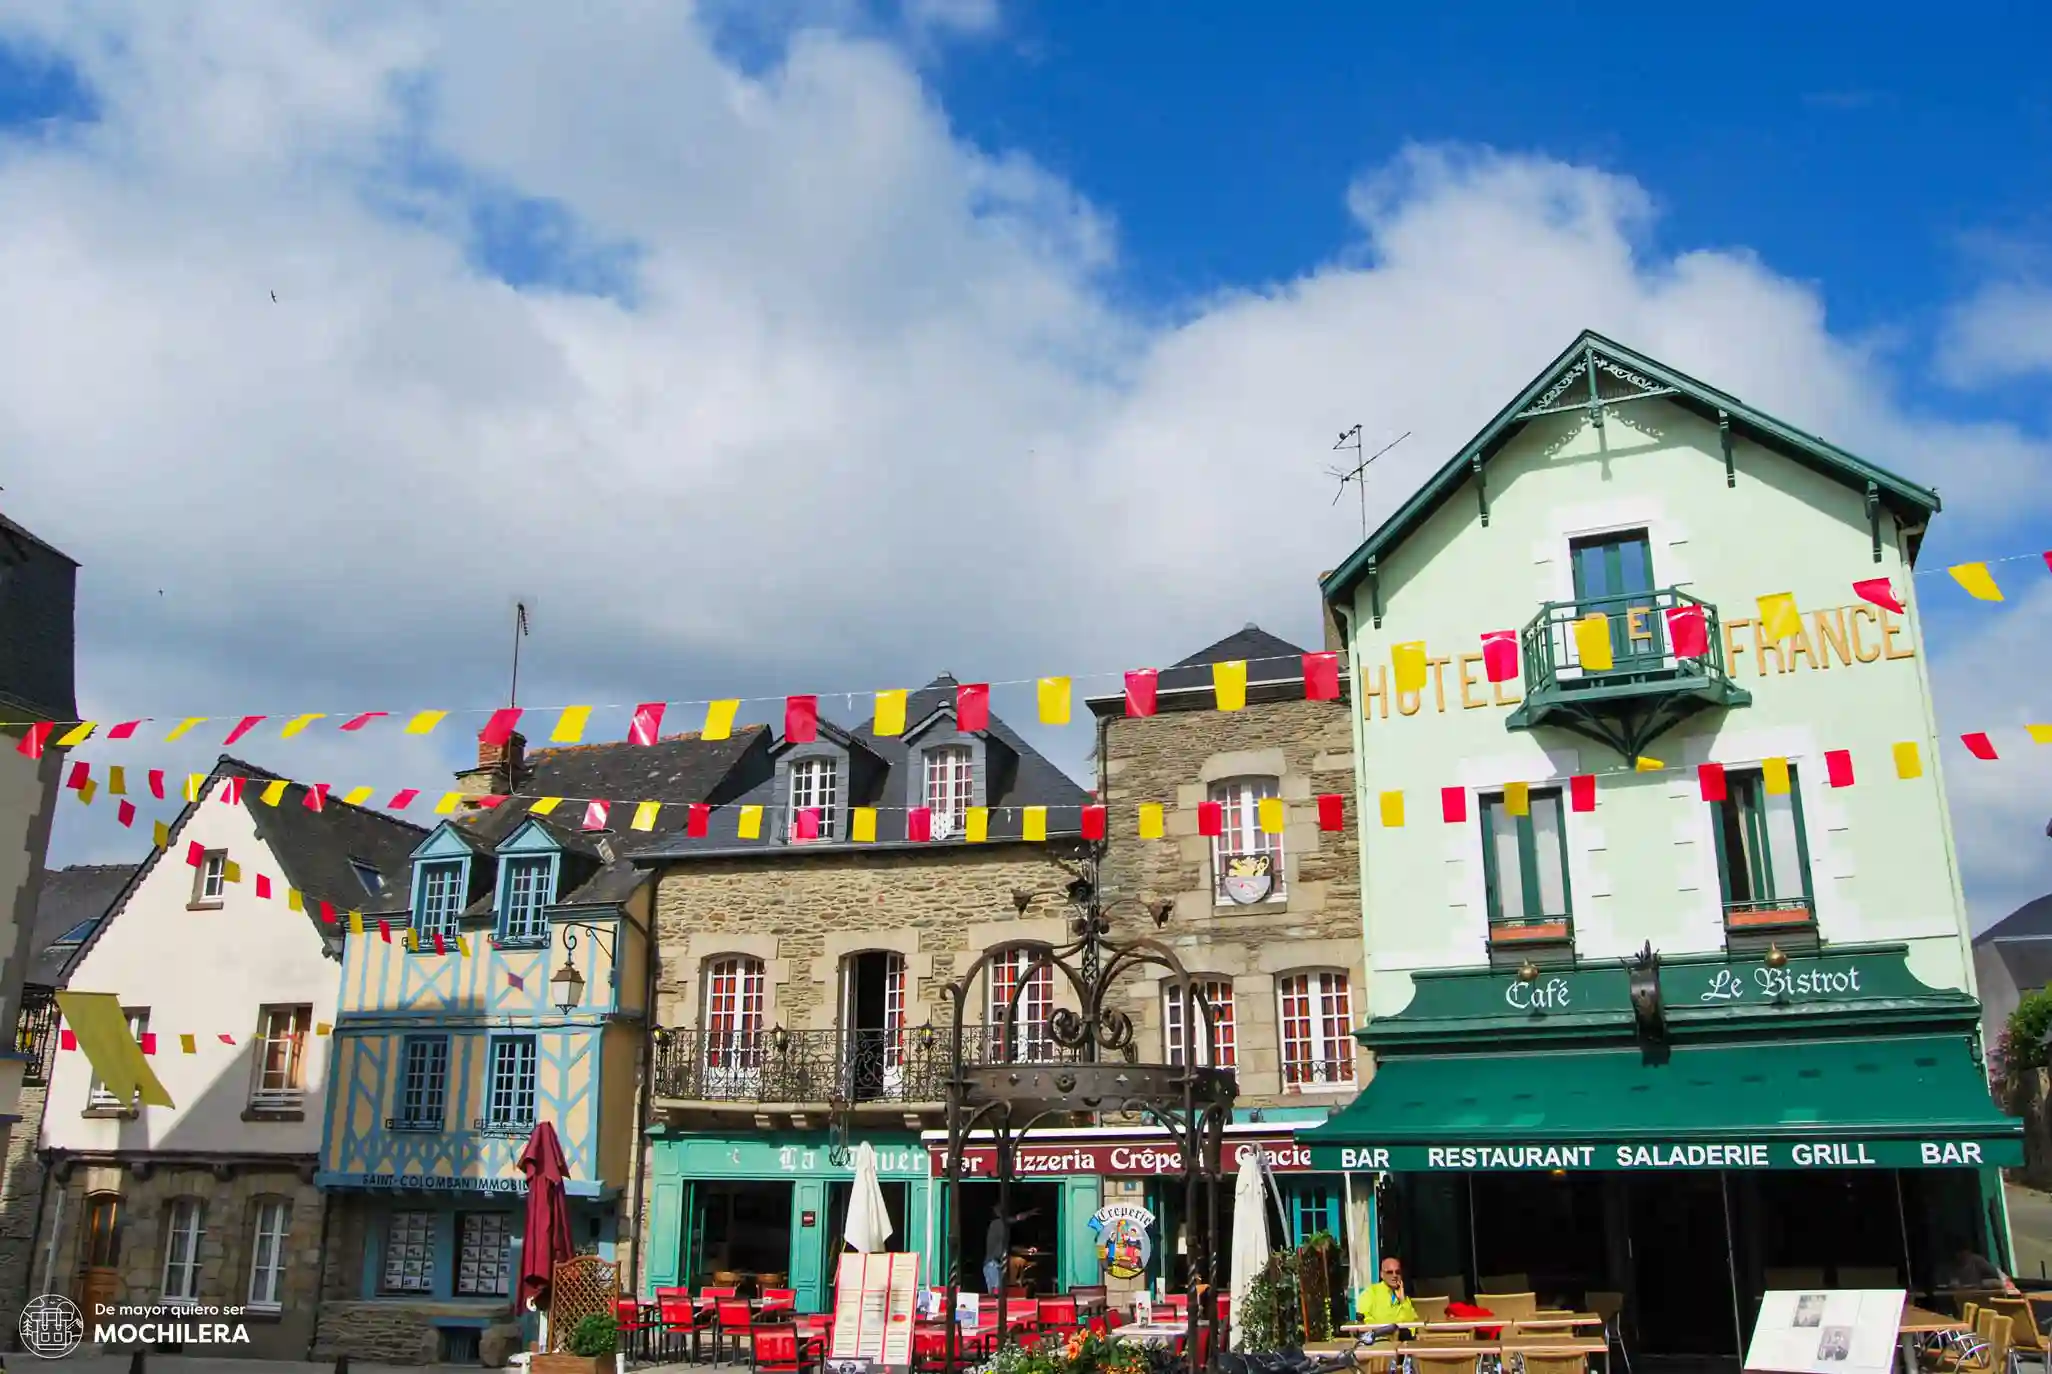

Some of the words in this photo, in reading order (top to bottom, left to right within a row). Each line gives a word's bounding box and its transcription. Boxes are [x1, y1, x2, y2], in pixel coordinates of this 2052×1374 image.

[1585, 607, 1652, 640] E
[1723, 598, 1915, 679] FRANCE
[1505, 978, 1571, 1009] Café
[1700, 969, 1744, 1001] Le
[1754, 965, 1861, 997] Bistrot
[779, 1145, 815, 1172] La
[1013, 1148, 1095, 1172] izzeria
[1341, 1148, 1390, 1168] BAR
[1428, 1146, 1595, 1167] RESTAURANT
[1616, 1144, 1769, 1167] SALADERIE
[1792, 1143, 1876, 1165] GRILL
[1921, 1142, 1984, 1165] BAR
